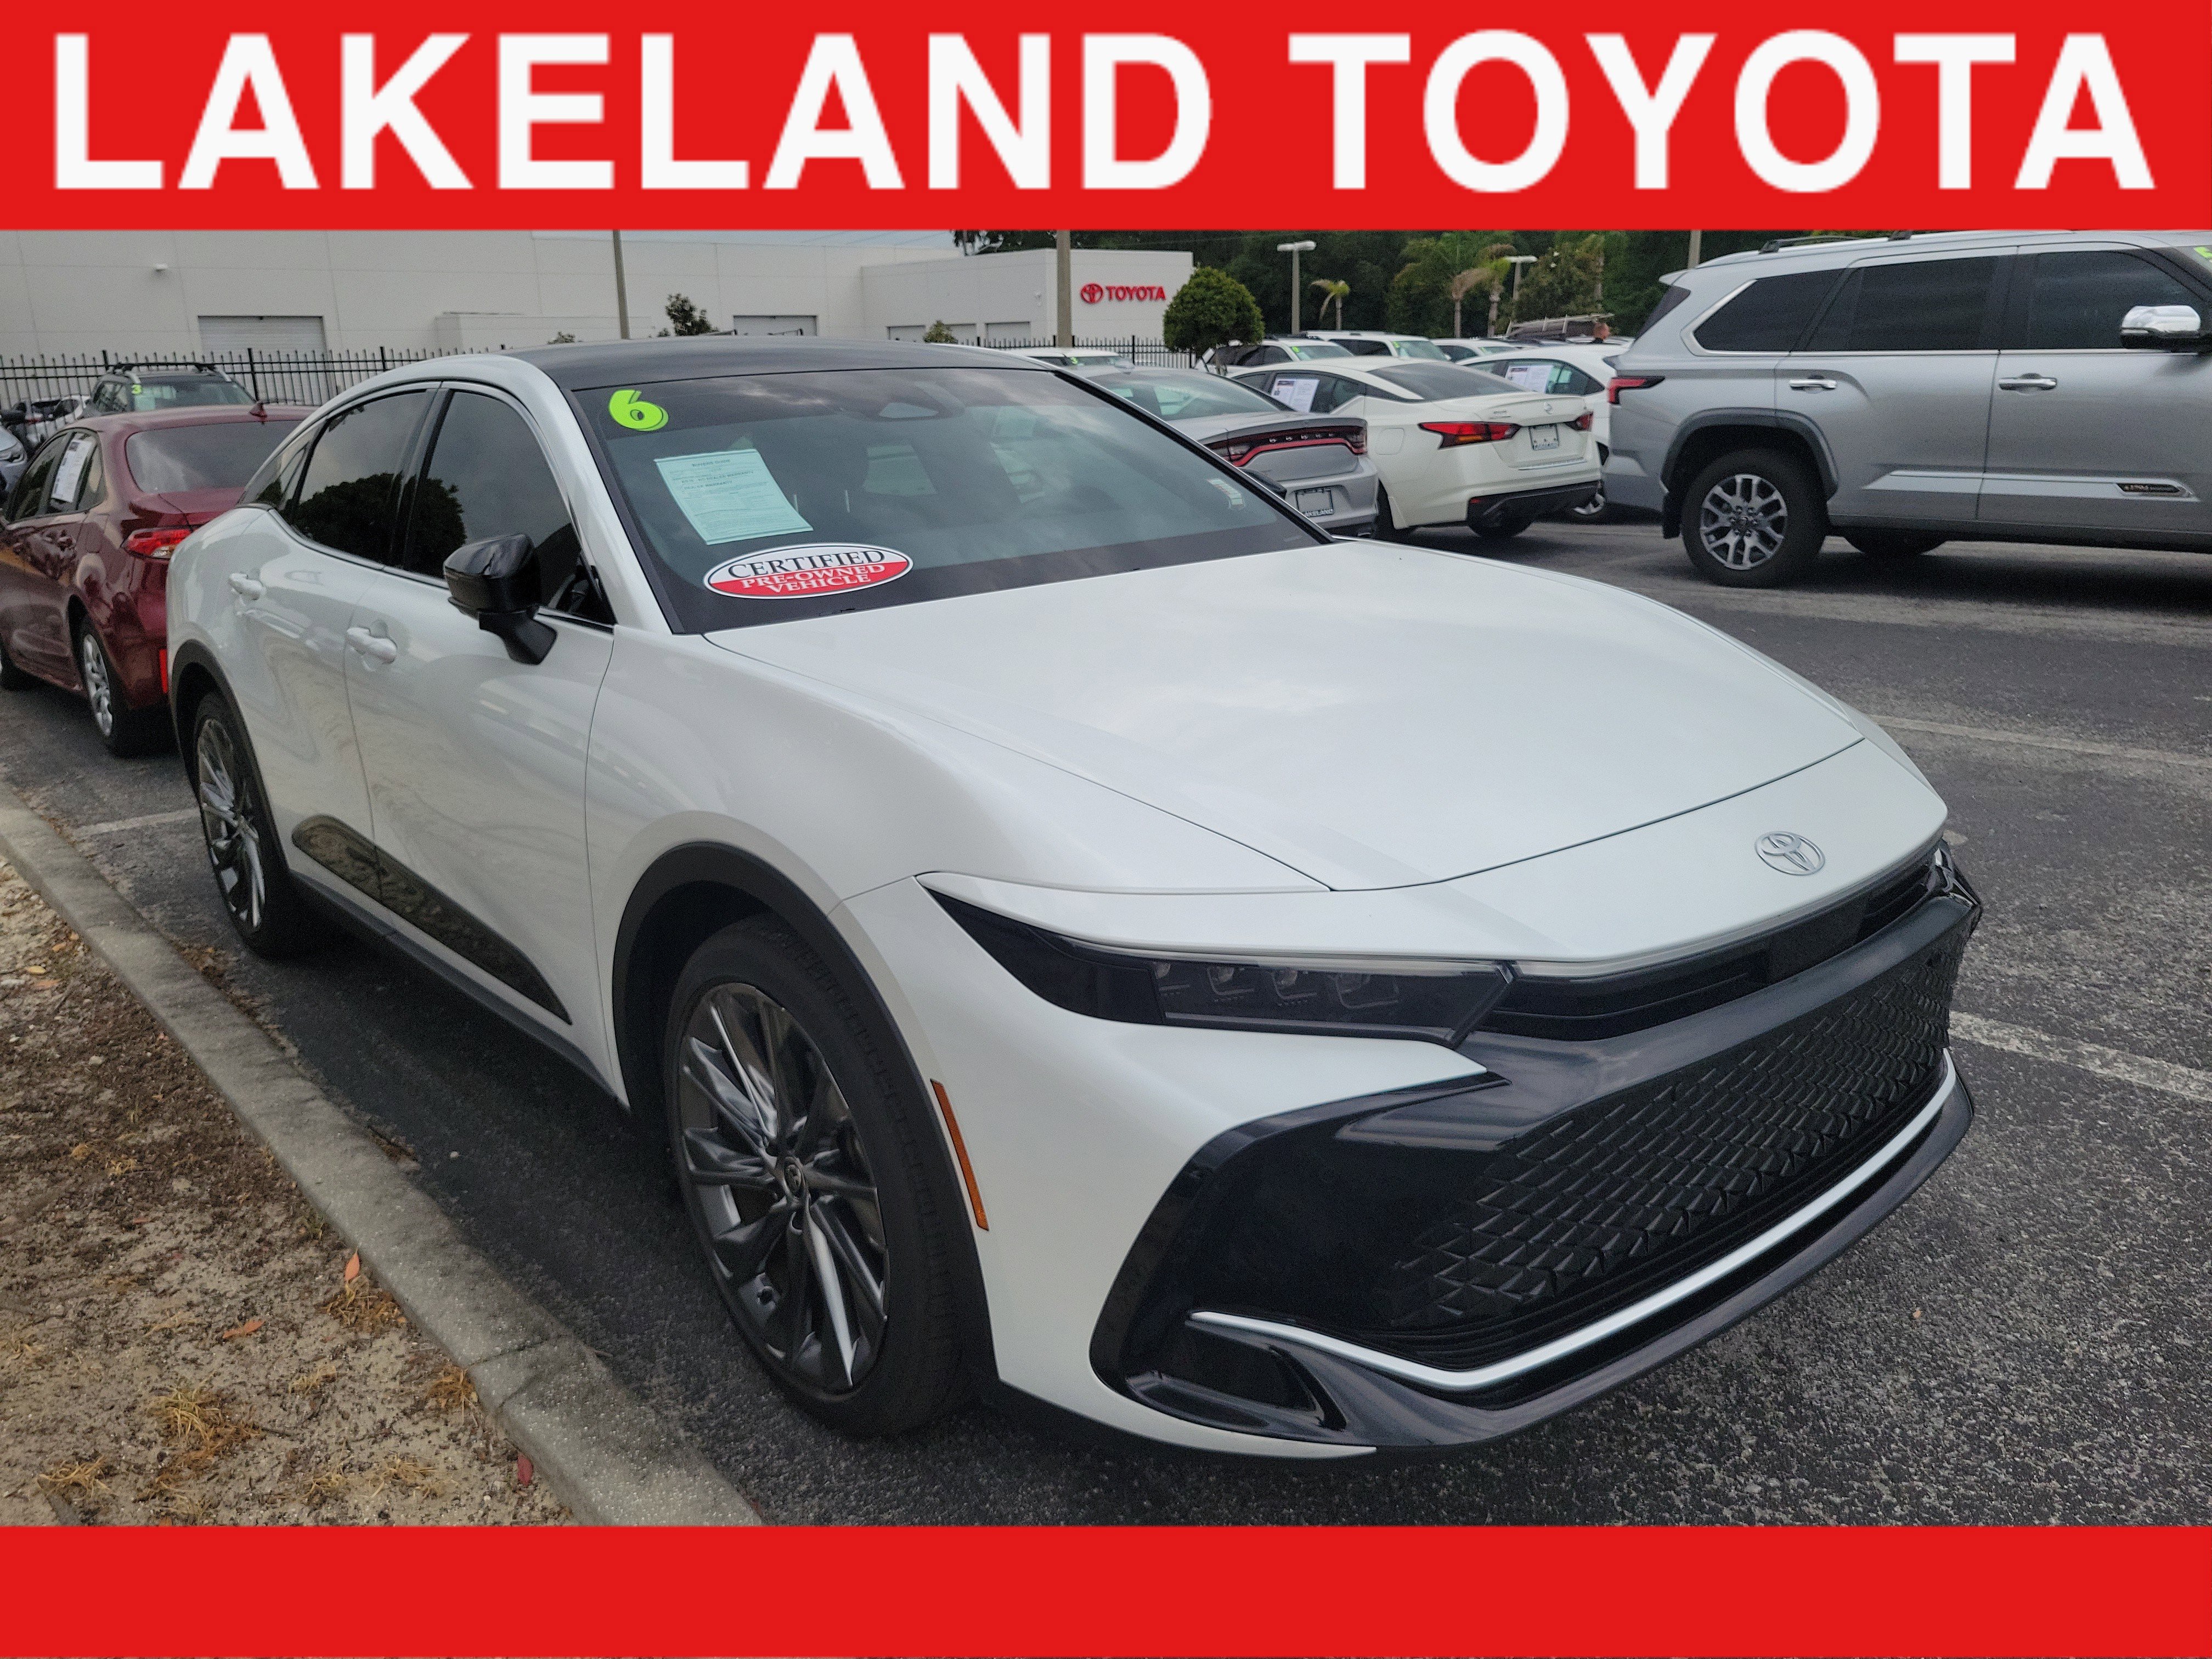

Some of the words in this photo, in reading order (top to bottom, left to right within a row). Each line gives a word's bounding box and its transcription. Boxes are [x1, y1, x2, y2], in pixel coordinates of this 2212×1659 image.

[1106, 286, 1166, 301] TOYOTA
[608, 388, 669, 432] 6
[727, 550, 885, 579] CERTIFIED
[741, 563, 885, 589] PRE-OWNED
[768, 574, 871, 594] VEHICLE
